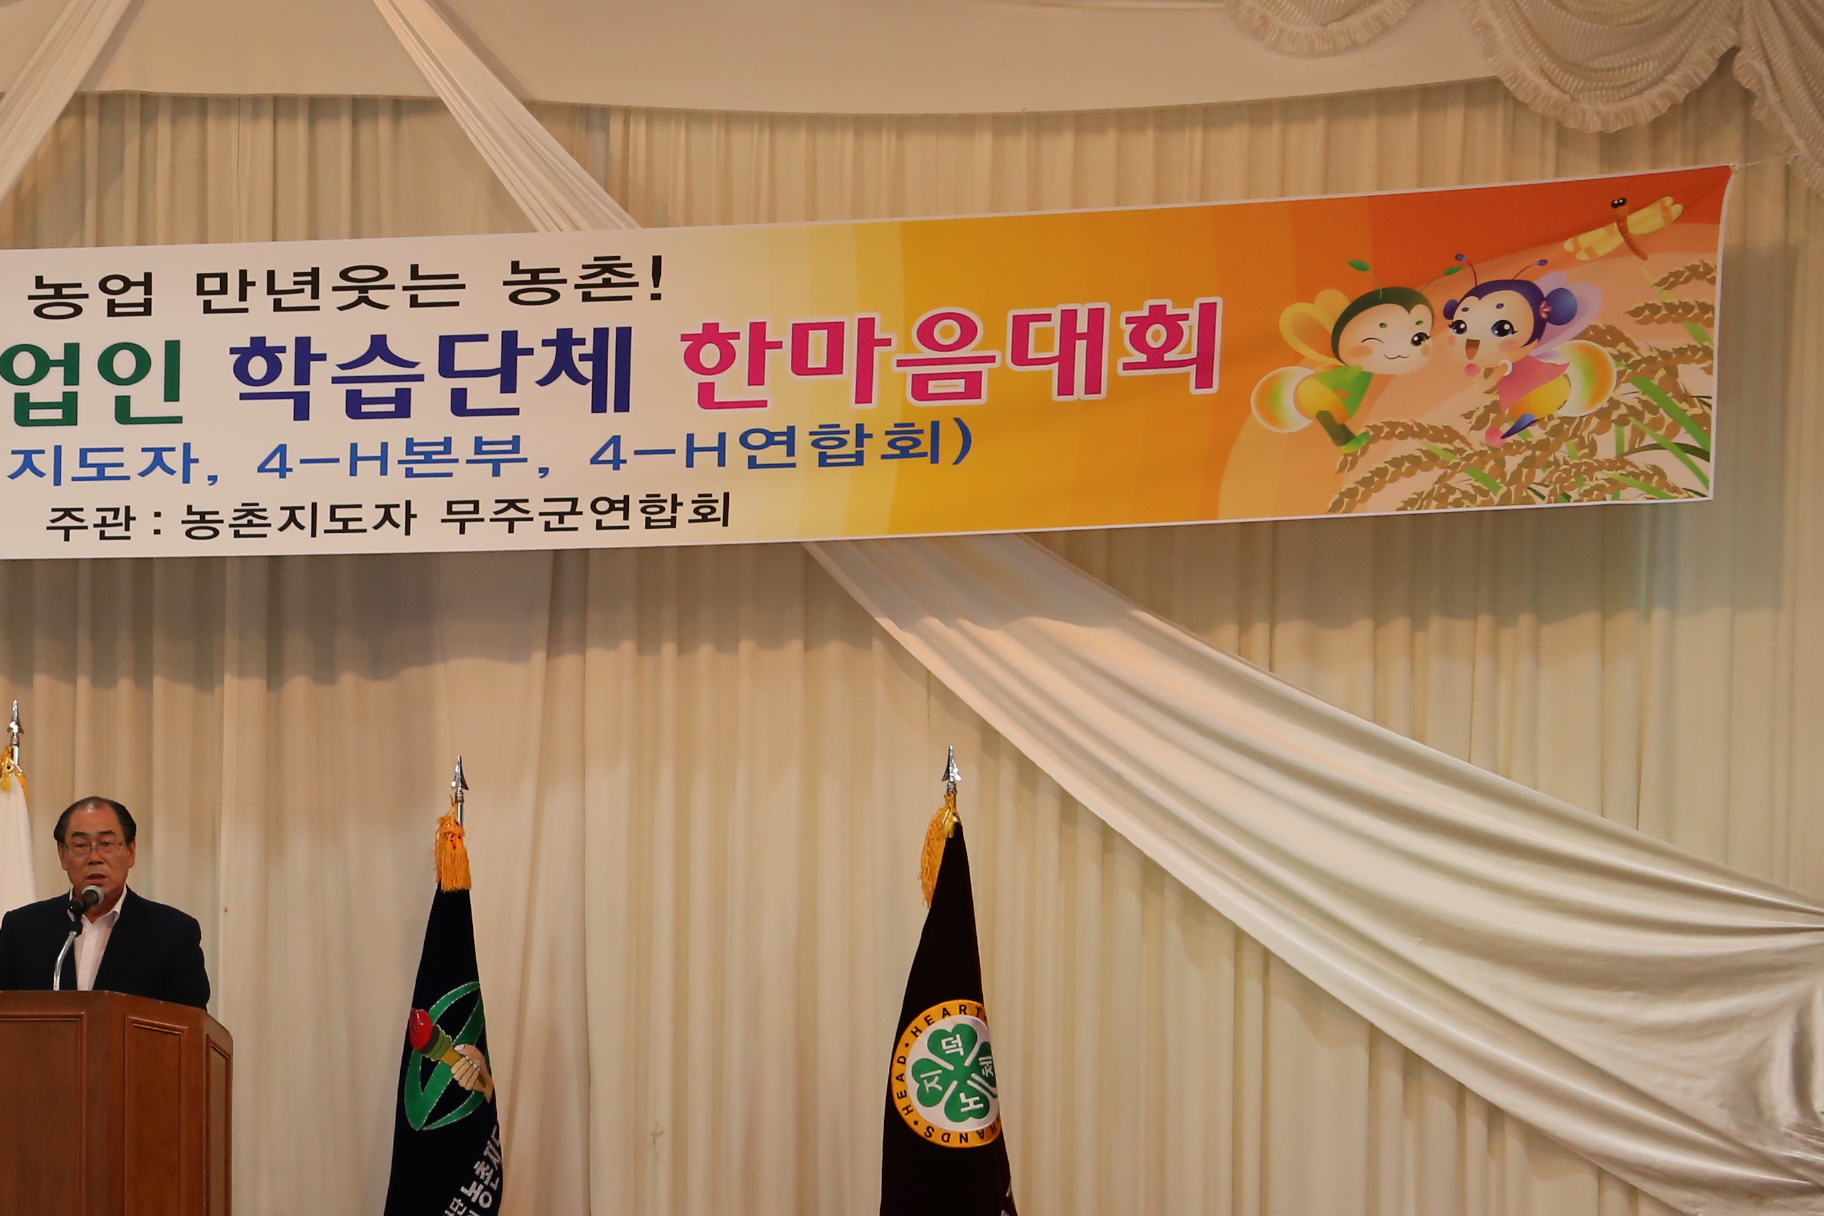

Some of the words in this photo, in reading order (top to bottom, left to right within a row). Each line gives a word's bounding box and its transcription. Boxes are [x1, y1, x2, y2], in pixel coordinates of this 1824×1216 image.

[27, 271, 155, 320] 농업
[195, 263, 467, 314] 만년웃는
[501, 254, 664, 306] 농촌!
[228, 325, 633, 422] 학습단체
[679, 299, 1220, 412] 한마음대회
[180, 500, 418, 542] 농촌지도자
[440, 491, 732, 536] 무주군연합회
[940, 1033, 965, 1056] 덕
[895, 1054, 915, 1117] HEAD
[920, 1069, 943, 1093] 지
[959, 1091, 985, 1112] 노
